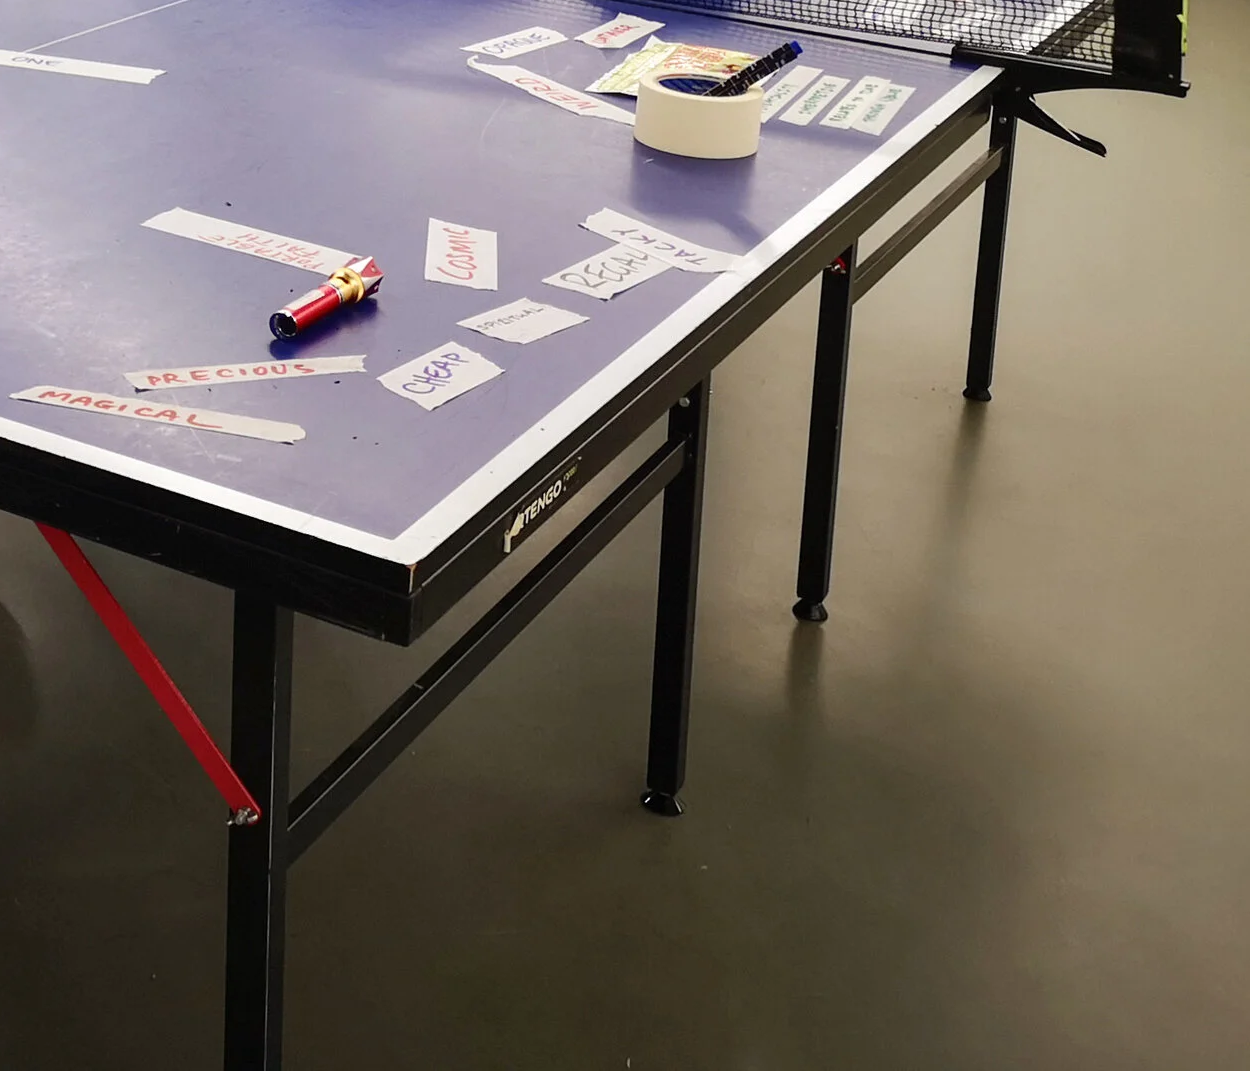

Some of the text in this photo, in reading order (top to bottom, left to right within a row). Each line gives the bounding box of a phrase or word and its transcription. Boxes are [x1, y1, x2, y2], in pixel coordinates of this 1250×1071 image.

[9, 55, 64, 68] ONE
[514, 77, 599, 110] WEIRD
[437, 227, 478, 280] COSMIC
[612, 229, 707, 266] TACKY
[147, 363, 315, 387] PRECIOUS
[402, 352, 470, 395] CHEAP
[37, 389, 223, 429] MAGICAL
